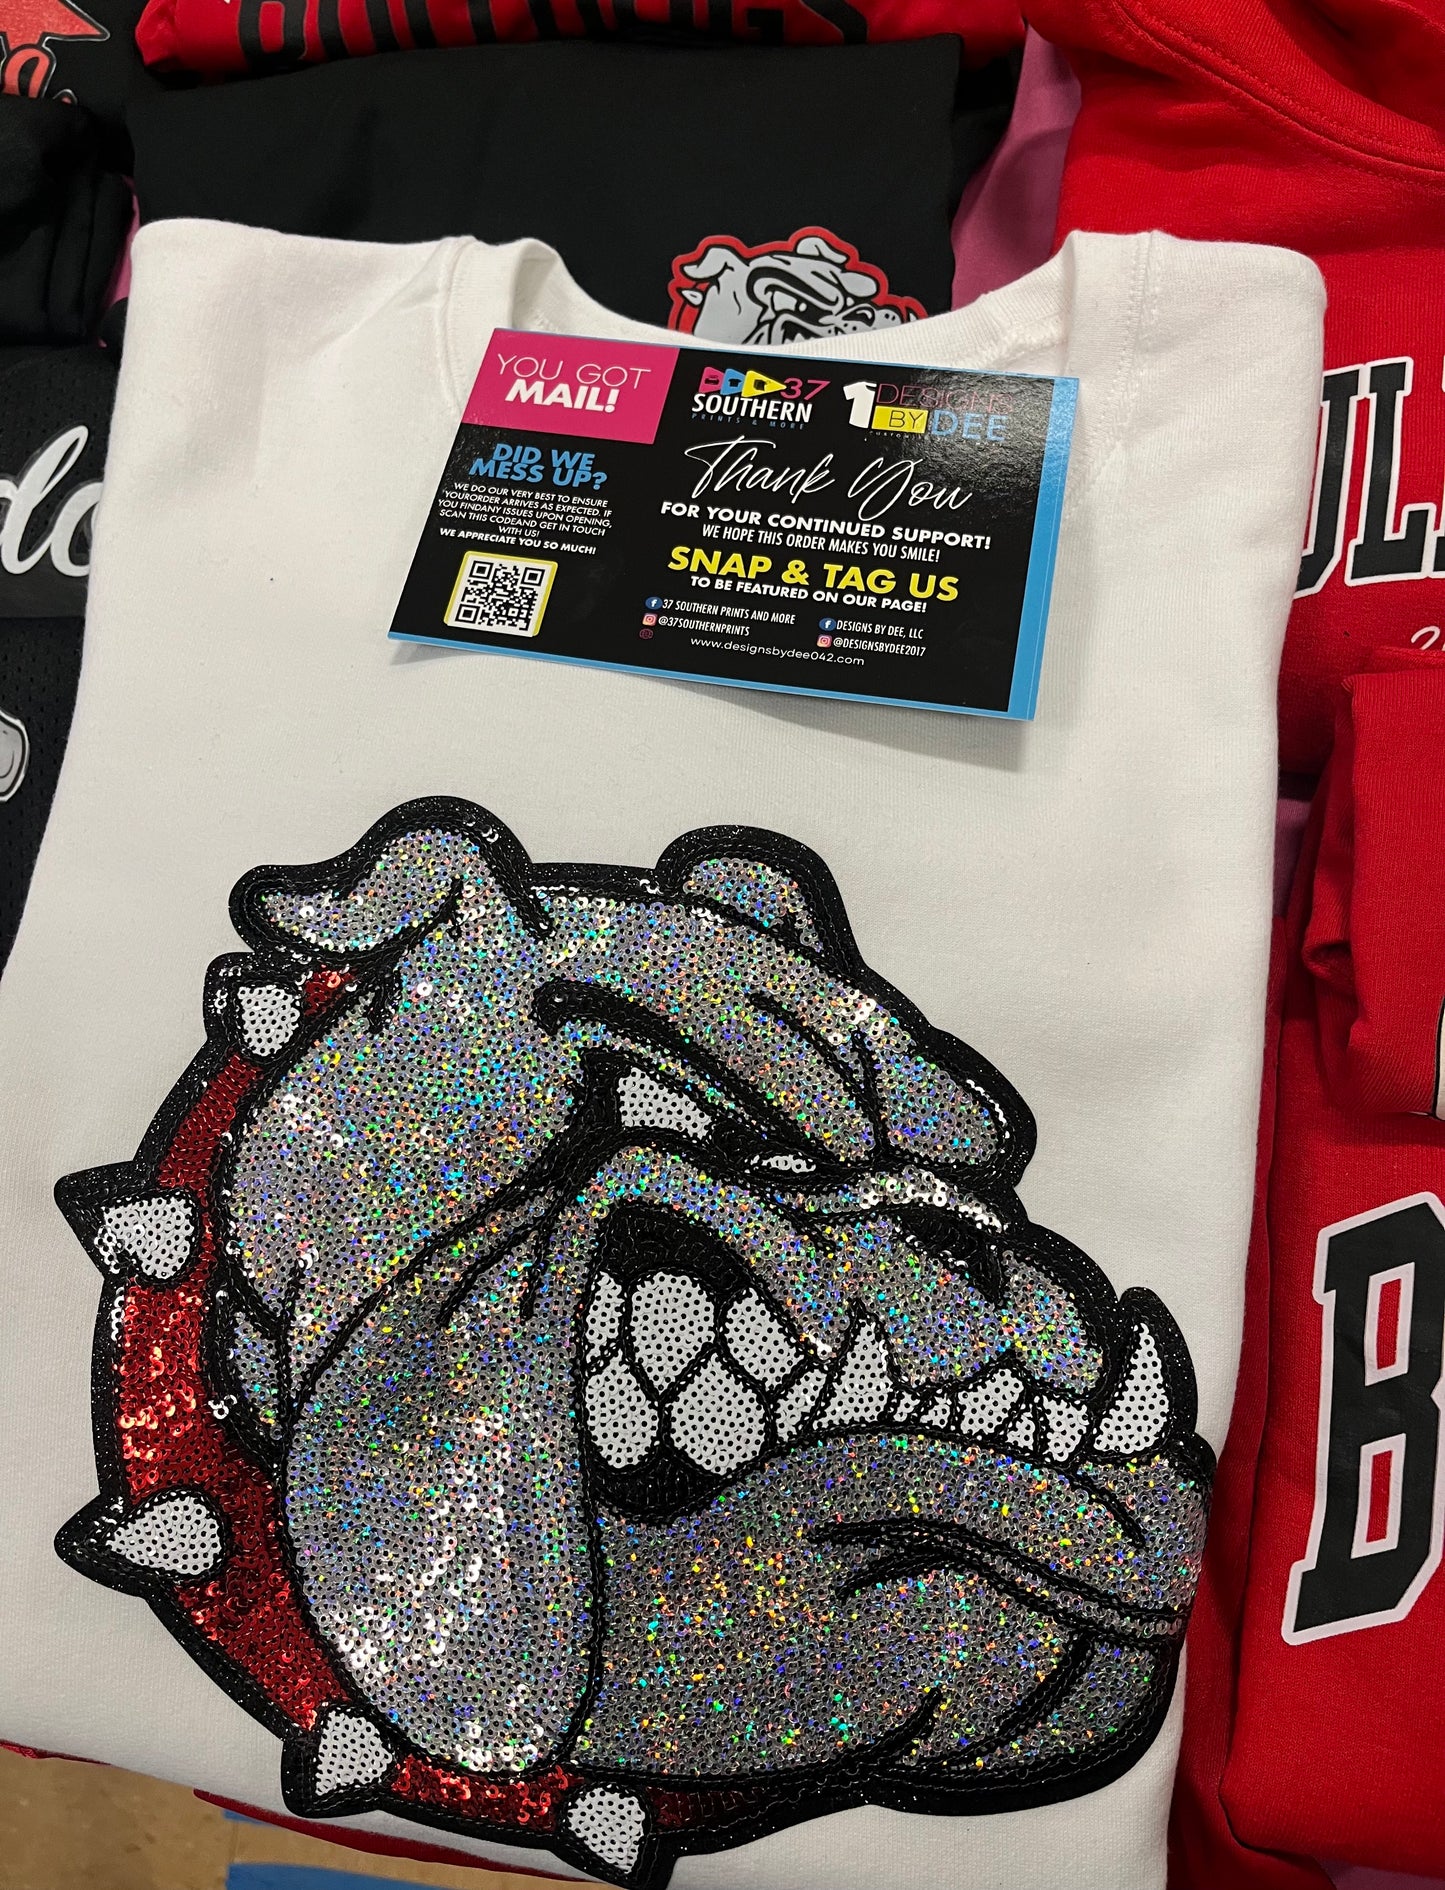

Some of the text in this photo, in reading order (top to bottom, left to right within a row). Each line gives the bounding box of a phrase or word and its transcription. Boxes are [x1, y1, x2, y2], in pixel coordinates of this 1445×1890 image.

[498, 354, 651, 389] YOU GOT
[505, 378, 620, 413] MAIL!
[780, 378, 831, 401] 37
[876, 383, 1014, 414] DESIGNS
[692, 393, 813, 423] SOUTHERN
[692, 413, 741, 424] PRINTS
[769, 420, 804, 430] MORE
[889, 410, 924, 429] BY
[931, 409, 1008, 441] DEE
[492, 443, 595, 471] DID WE
[469, 458, 608, 490] MESS UP?
[684, 435, 973, 522] Thank You
[445, 490, 613, 518] YOURORDER ARRIVES AS EXPECTED. IF
[454, 483, 608, 508] WE DO OUR VERY BEST TO ENSURE
[438, 499, 613, 529] YOU FINDANY ISSUES UPON OPENING,
[439, 509, 606, 537] SCAN THIS CODEAND GET IN TOUCH
[660, 501, 991, 550] FOR YOUR CONTINUED SUPPORT!
[439, 528, 597, 555] WE APPRECIATE YOU SO MUCH!
[498, 526, 540, 538] WITH US!
[702, 524, 940, 563] WE HOPE THIS ORDER MAKES YOU SMILE!
[668, 546, 960, 601] SNAP & TAG US
[690, 575, 927, 613] TO BE FEATURED ON OUR PAGE!
[658, 616, 750, 637] @37SOUTHERNPRINTS
[662, 599, 796, 625] 37 SOUTHERN PRINTS AND MORE
[836, 620, 924, 639] DESIGNS BY DEE, LLC
[690, 637, 865, 666] www.designsbydee042.com
[833, 637, 927, 657] @DESIGNSBYDEE2017
